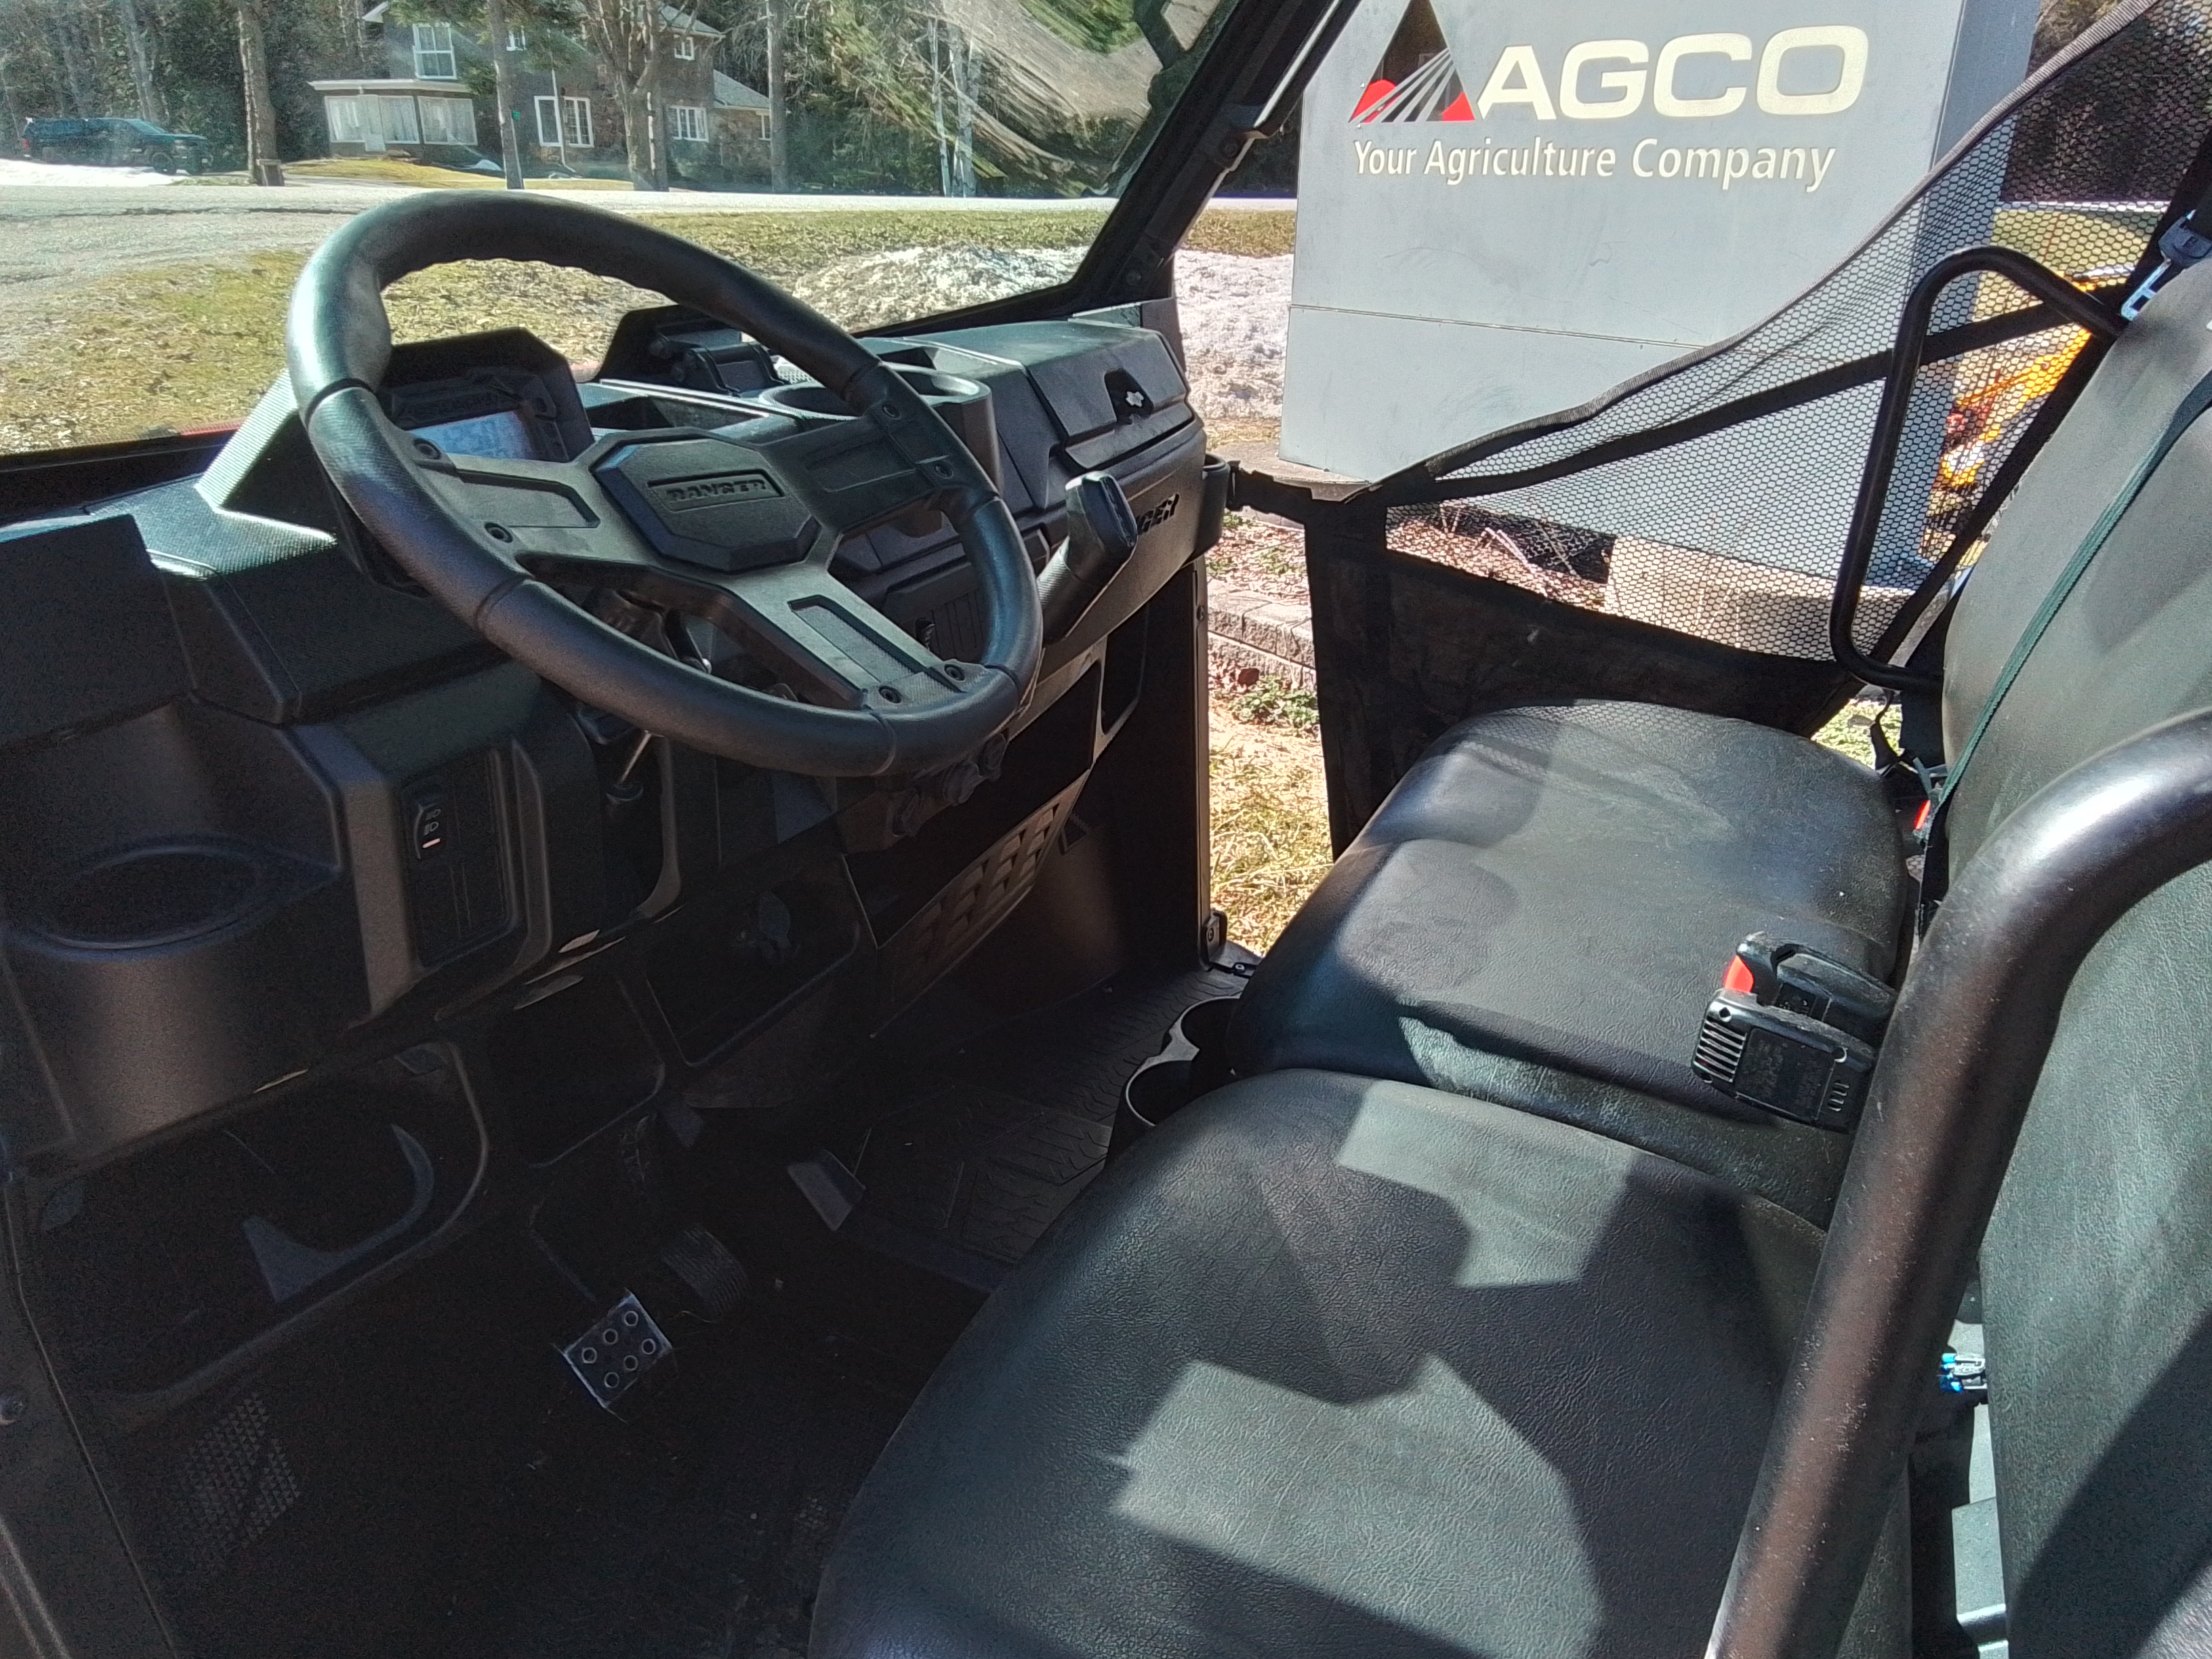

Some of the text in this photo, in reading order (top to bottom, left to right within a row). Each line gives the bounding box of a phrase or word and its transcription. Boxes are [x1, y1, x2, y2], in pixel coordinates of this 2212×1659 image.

[1477, 25, 1869, 121] AGCO
[1354, 136, 1837, 193] Your Agriculture Company
